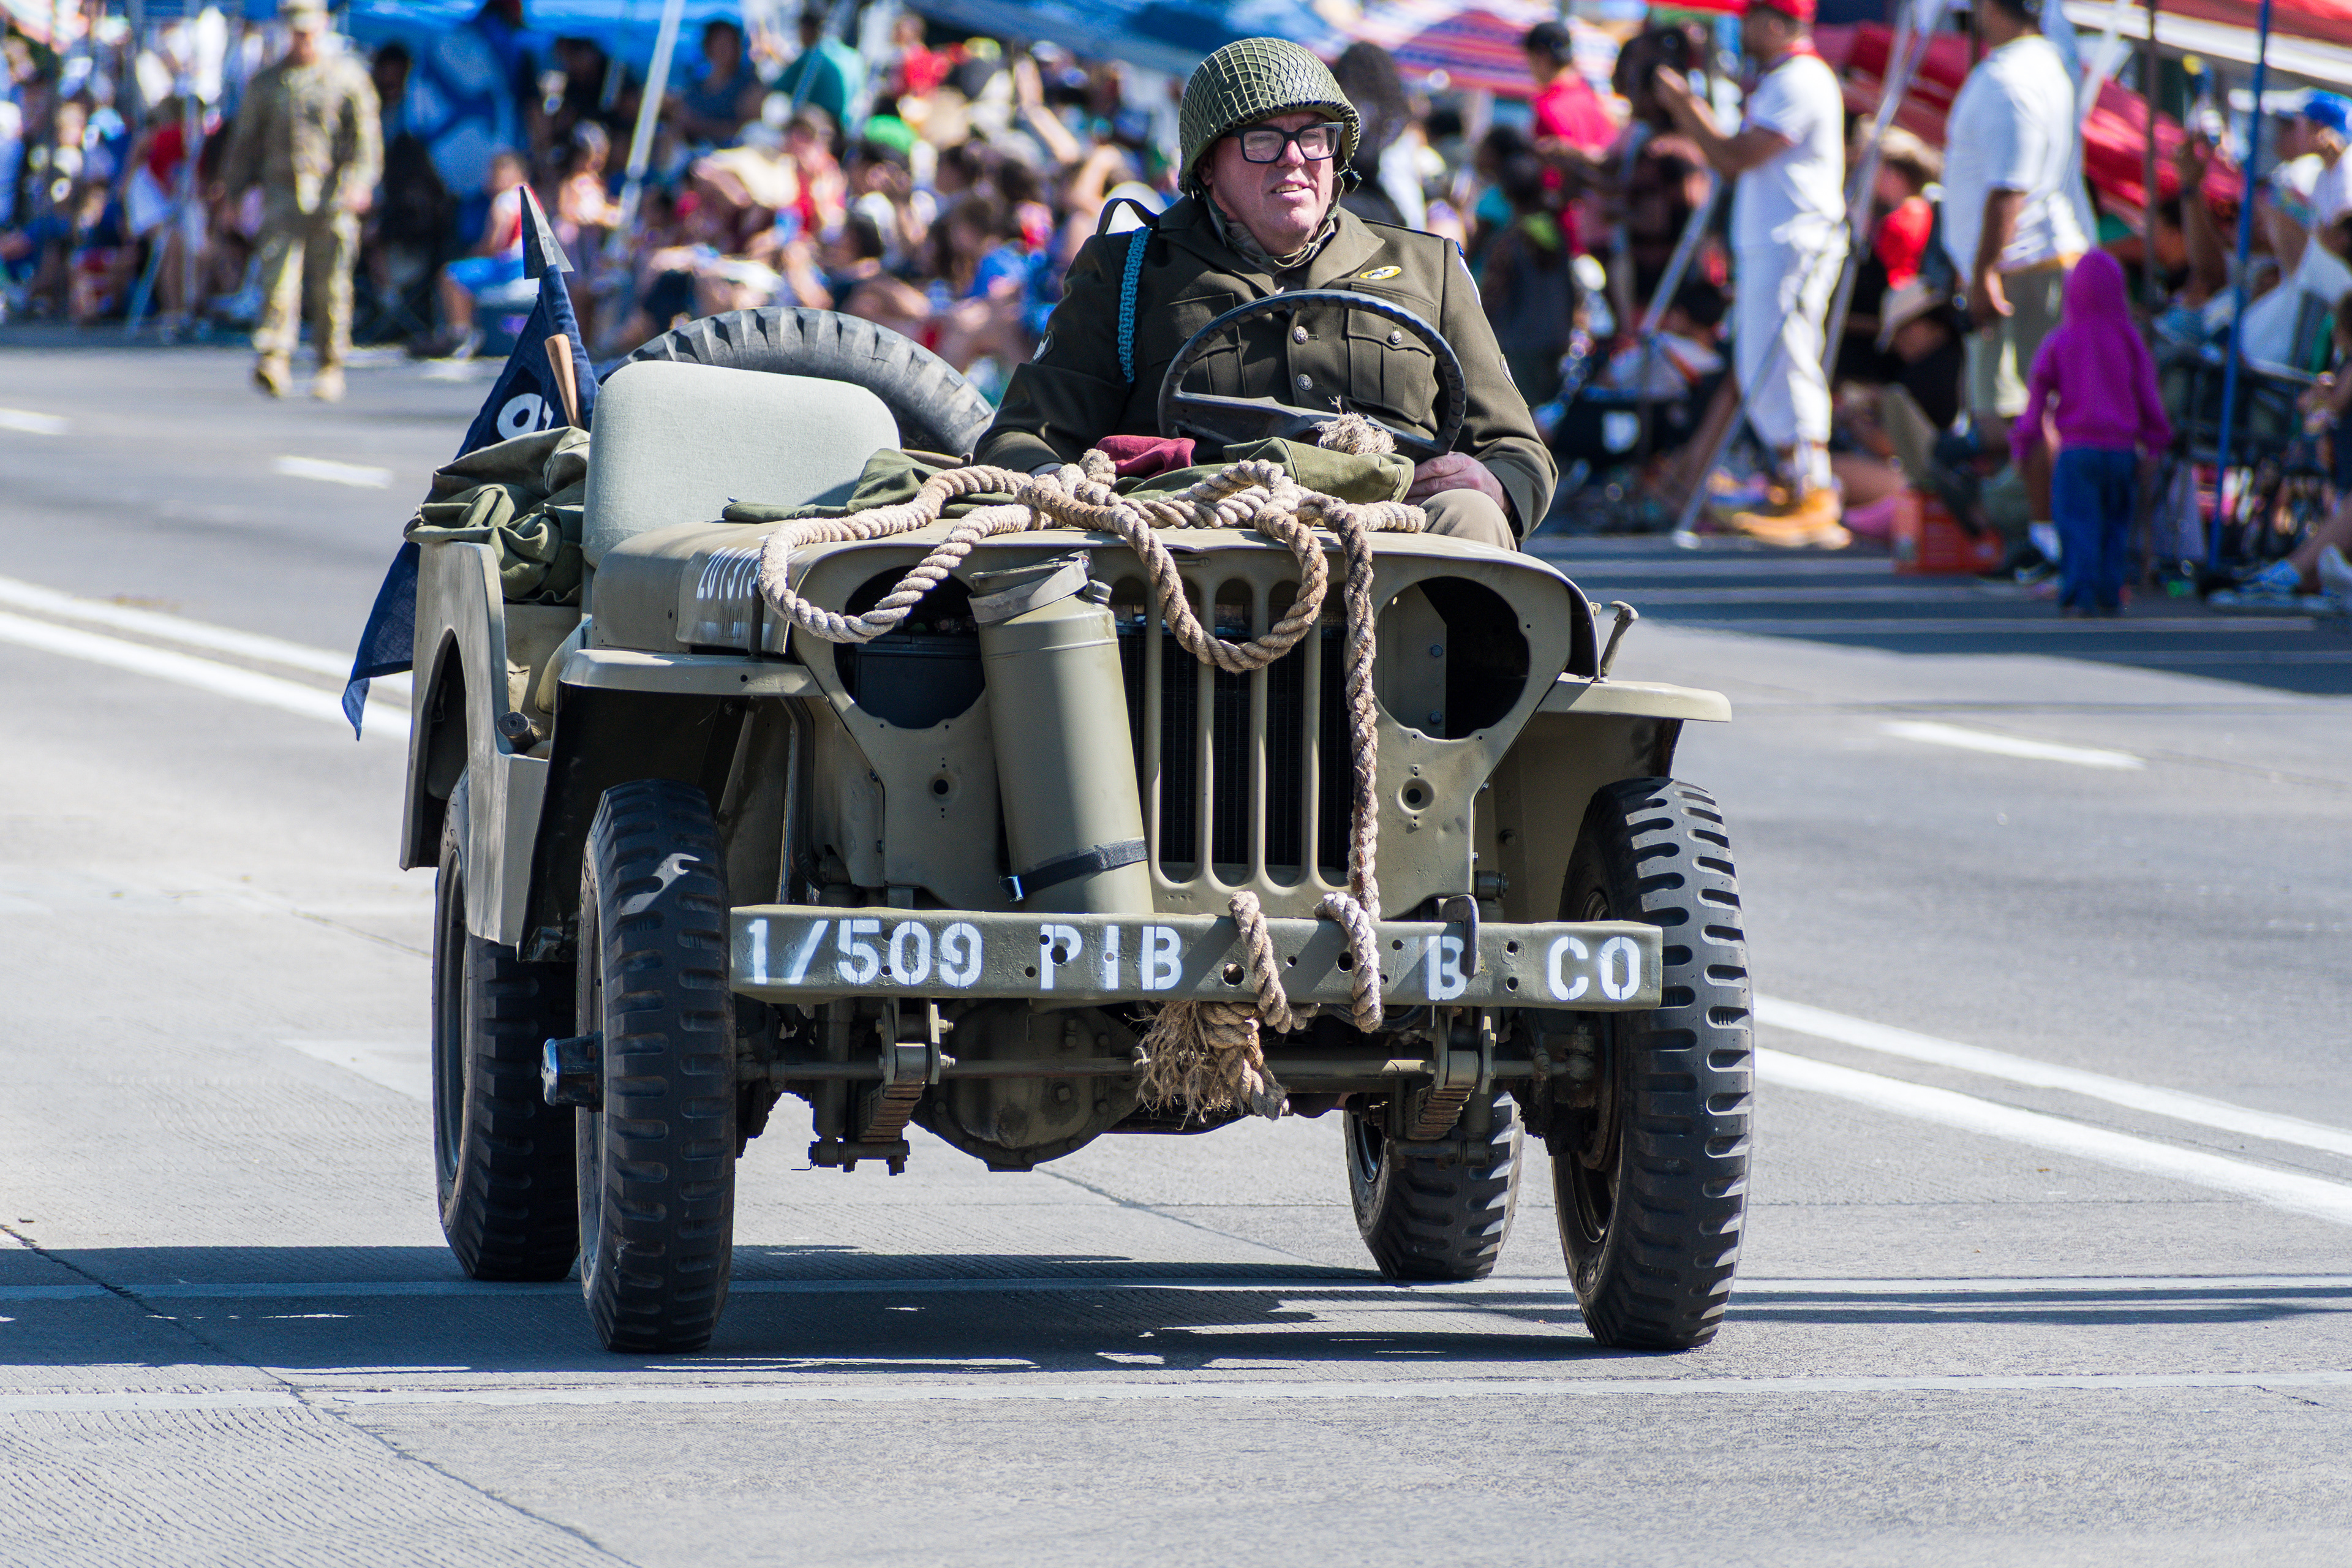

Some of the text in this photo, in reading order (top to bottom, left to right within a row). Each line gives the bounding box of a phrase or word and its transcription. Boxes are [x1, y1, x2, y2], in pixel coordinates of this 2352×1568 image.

[747, 919, 1642, 1001] 1/509 PIB B CO
